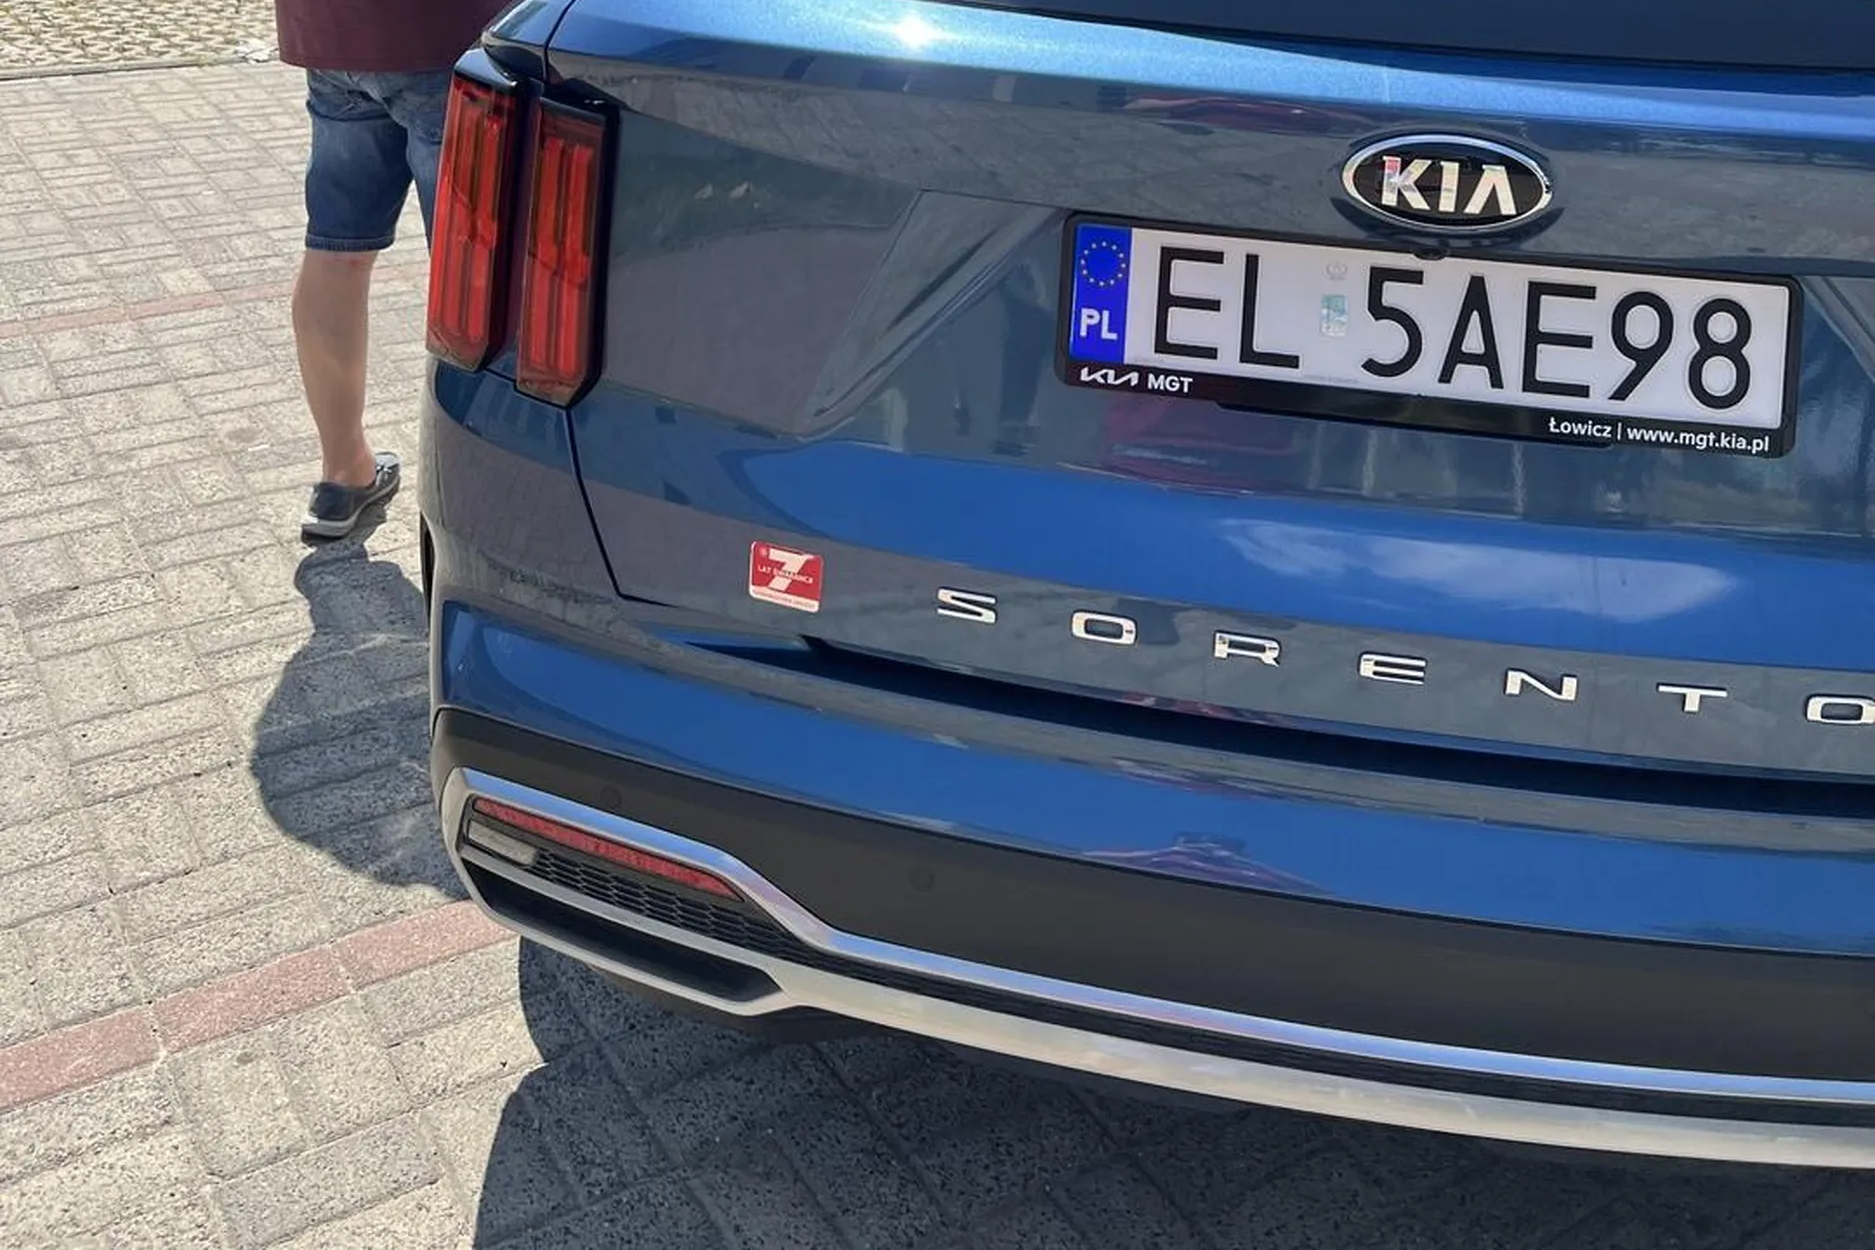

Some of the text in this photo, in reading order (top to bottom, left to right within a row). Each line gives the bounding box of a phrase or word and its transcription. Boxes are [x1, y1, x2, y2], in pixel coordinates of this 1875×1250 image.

[1381, 155, 1517, 217] KIA
[1080, 308, 1118, 341] PL
[1154, 245, 1754, 410] EL 5AE98
[1147, 373, 1194, 394] MGT
[1548, 416, 1612, 440] Łowicz
[1626, 425, 1770, 455] www.mgt.kia.pl
[936, 586, 1875, 727] SORENTO
